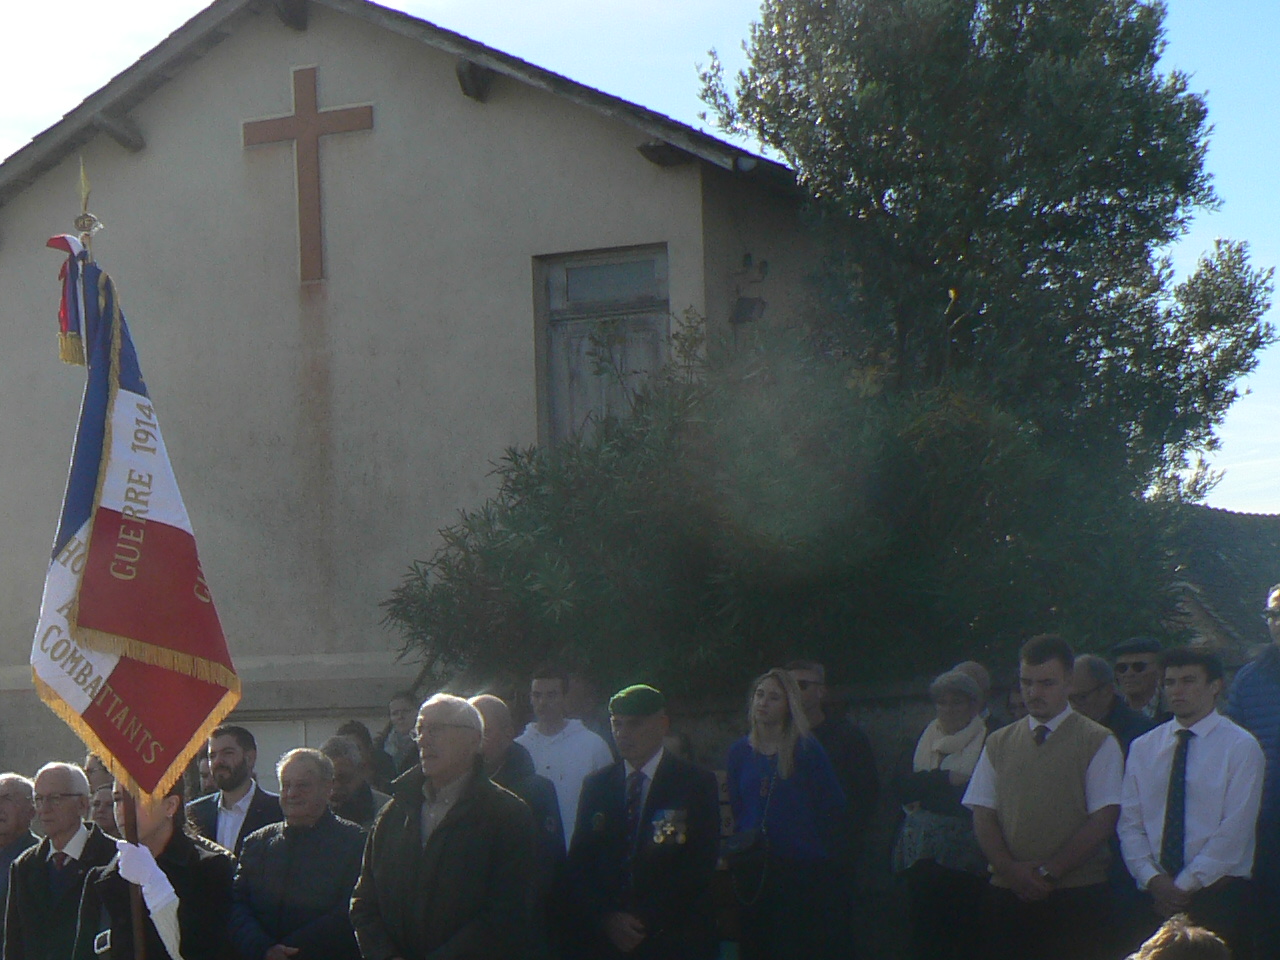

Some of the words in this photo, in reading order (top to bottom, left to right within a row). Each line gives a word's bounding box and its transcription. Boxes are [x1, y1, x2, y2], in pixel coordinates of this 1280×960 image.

[131, 402, 158, 456] 1914
[109, 468, 154, 581] GUERRE
[40, 624, 165, 765] COMBATTANTS
